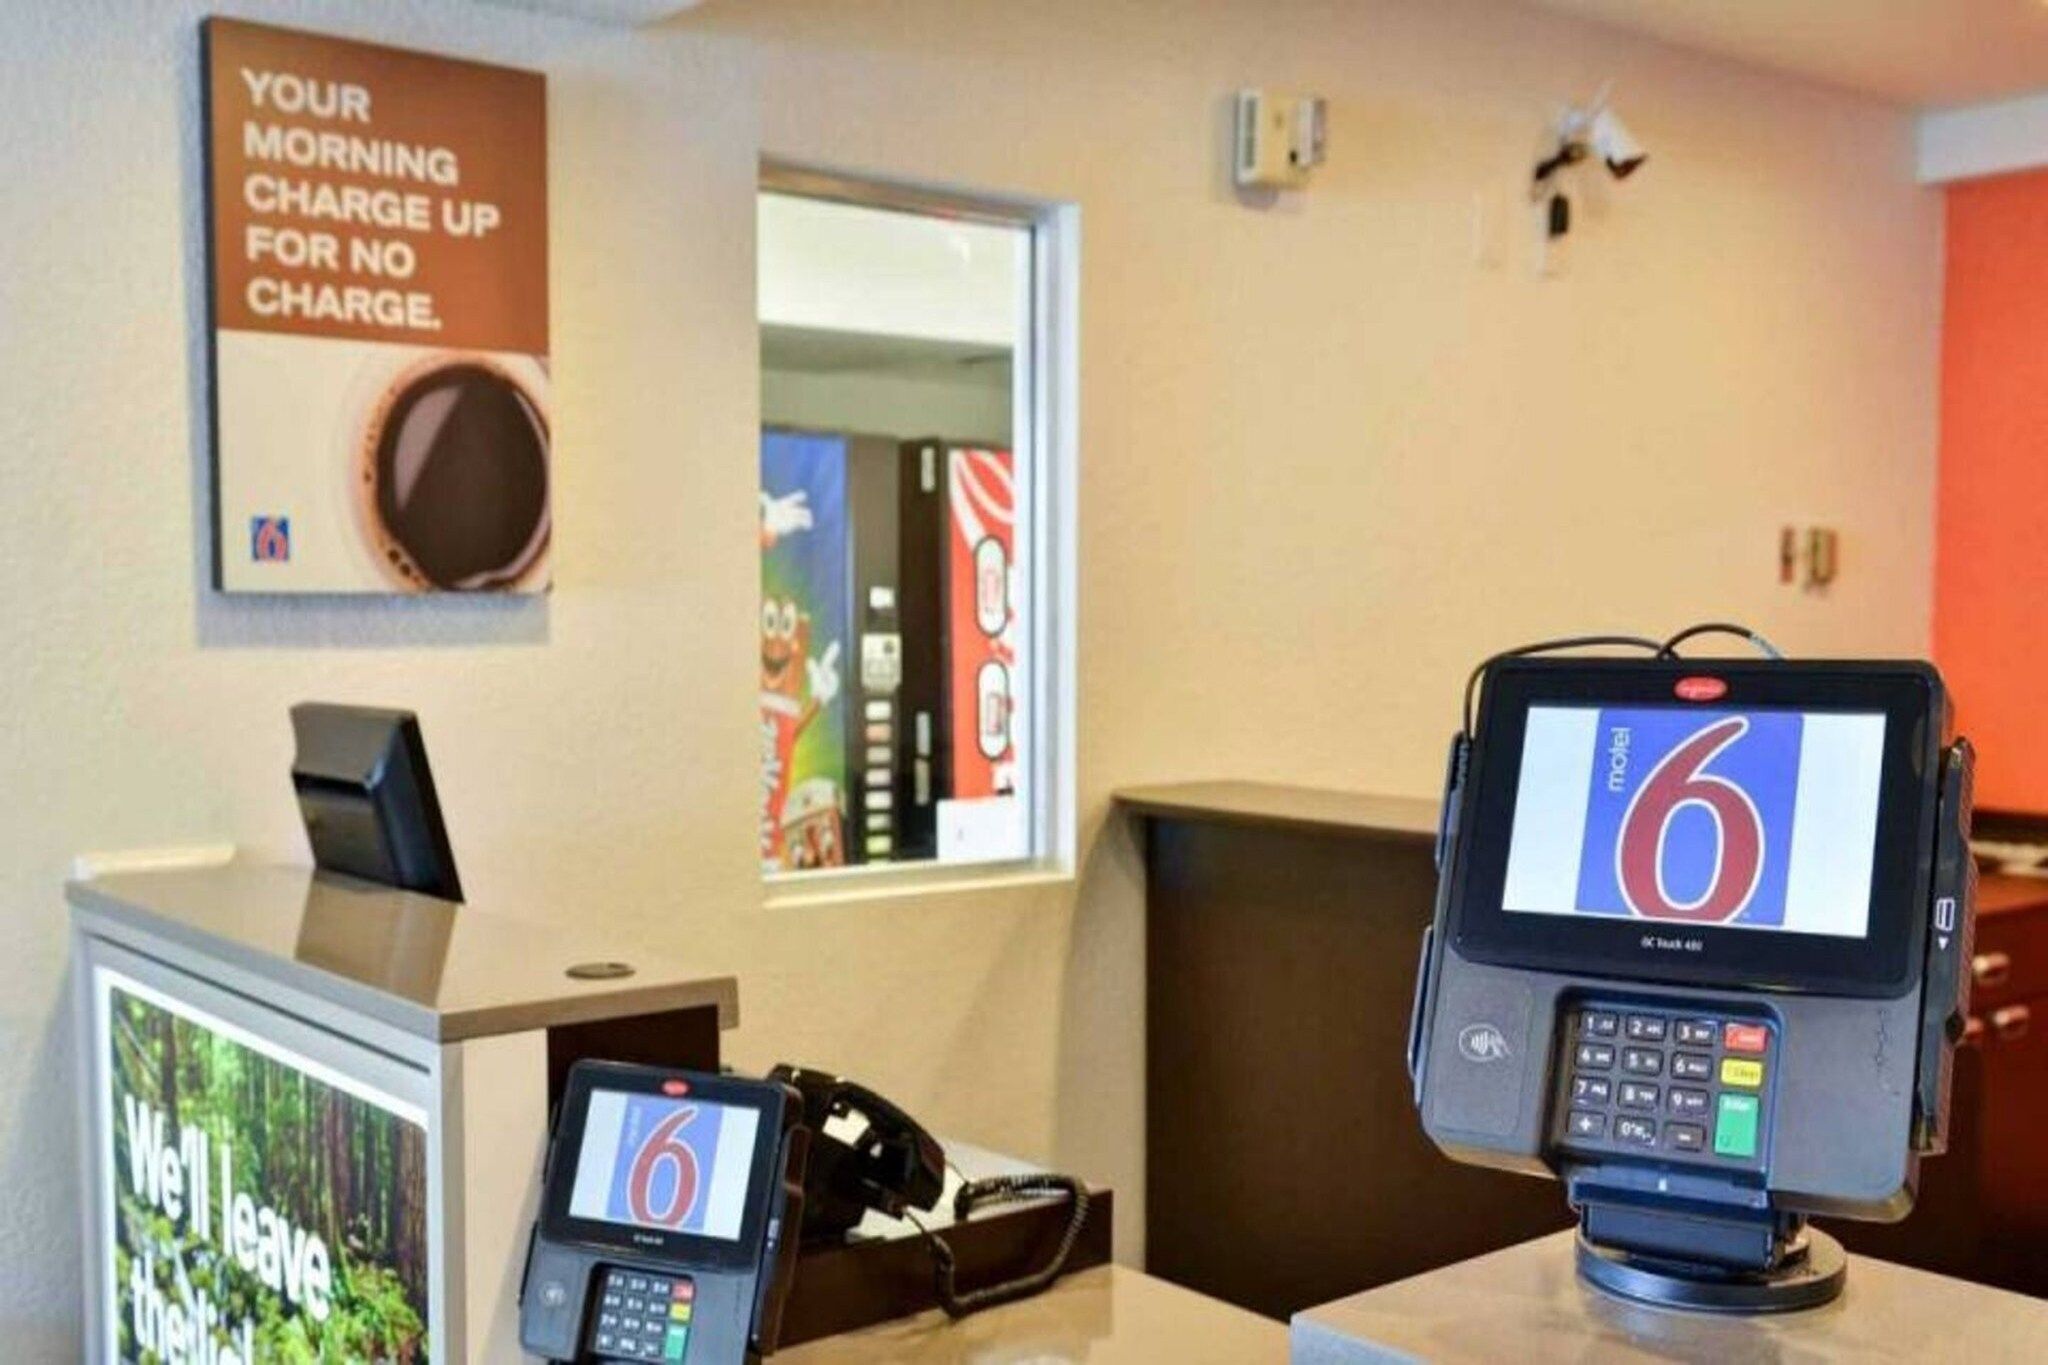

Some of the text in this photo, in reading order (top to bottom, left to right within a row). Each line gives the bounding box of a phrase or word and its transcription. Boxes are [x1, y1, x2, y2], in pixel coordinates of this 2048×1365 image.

[241, 67, 371, 123] YOUR
[243, 121, 459, 186] MORNING
[244, 174, 500, 237] CHARGE UP
[246, 226, 416, 279] FOR NO
[246, 277, 443, 330] CHARGE.
[257, 517, 288, 562] 6
[1608, 727, 1631, 791] motel
[1615, 715, 1765, 926] 6
[1632, 1021, 1642, 1034] 2
[1577, 1081, 1586, 1094] 7
[626, 1105, 699, 1229] 6
[221, 1143, 332, 1321] leave
